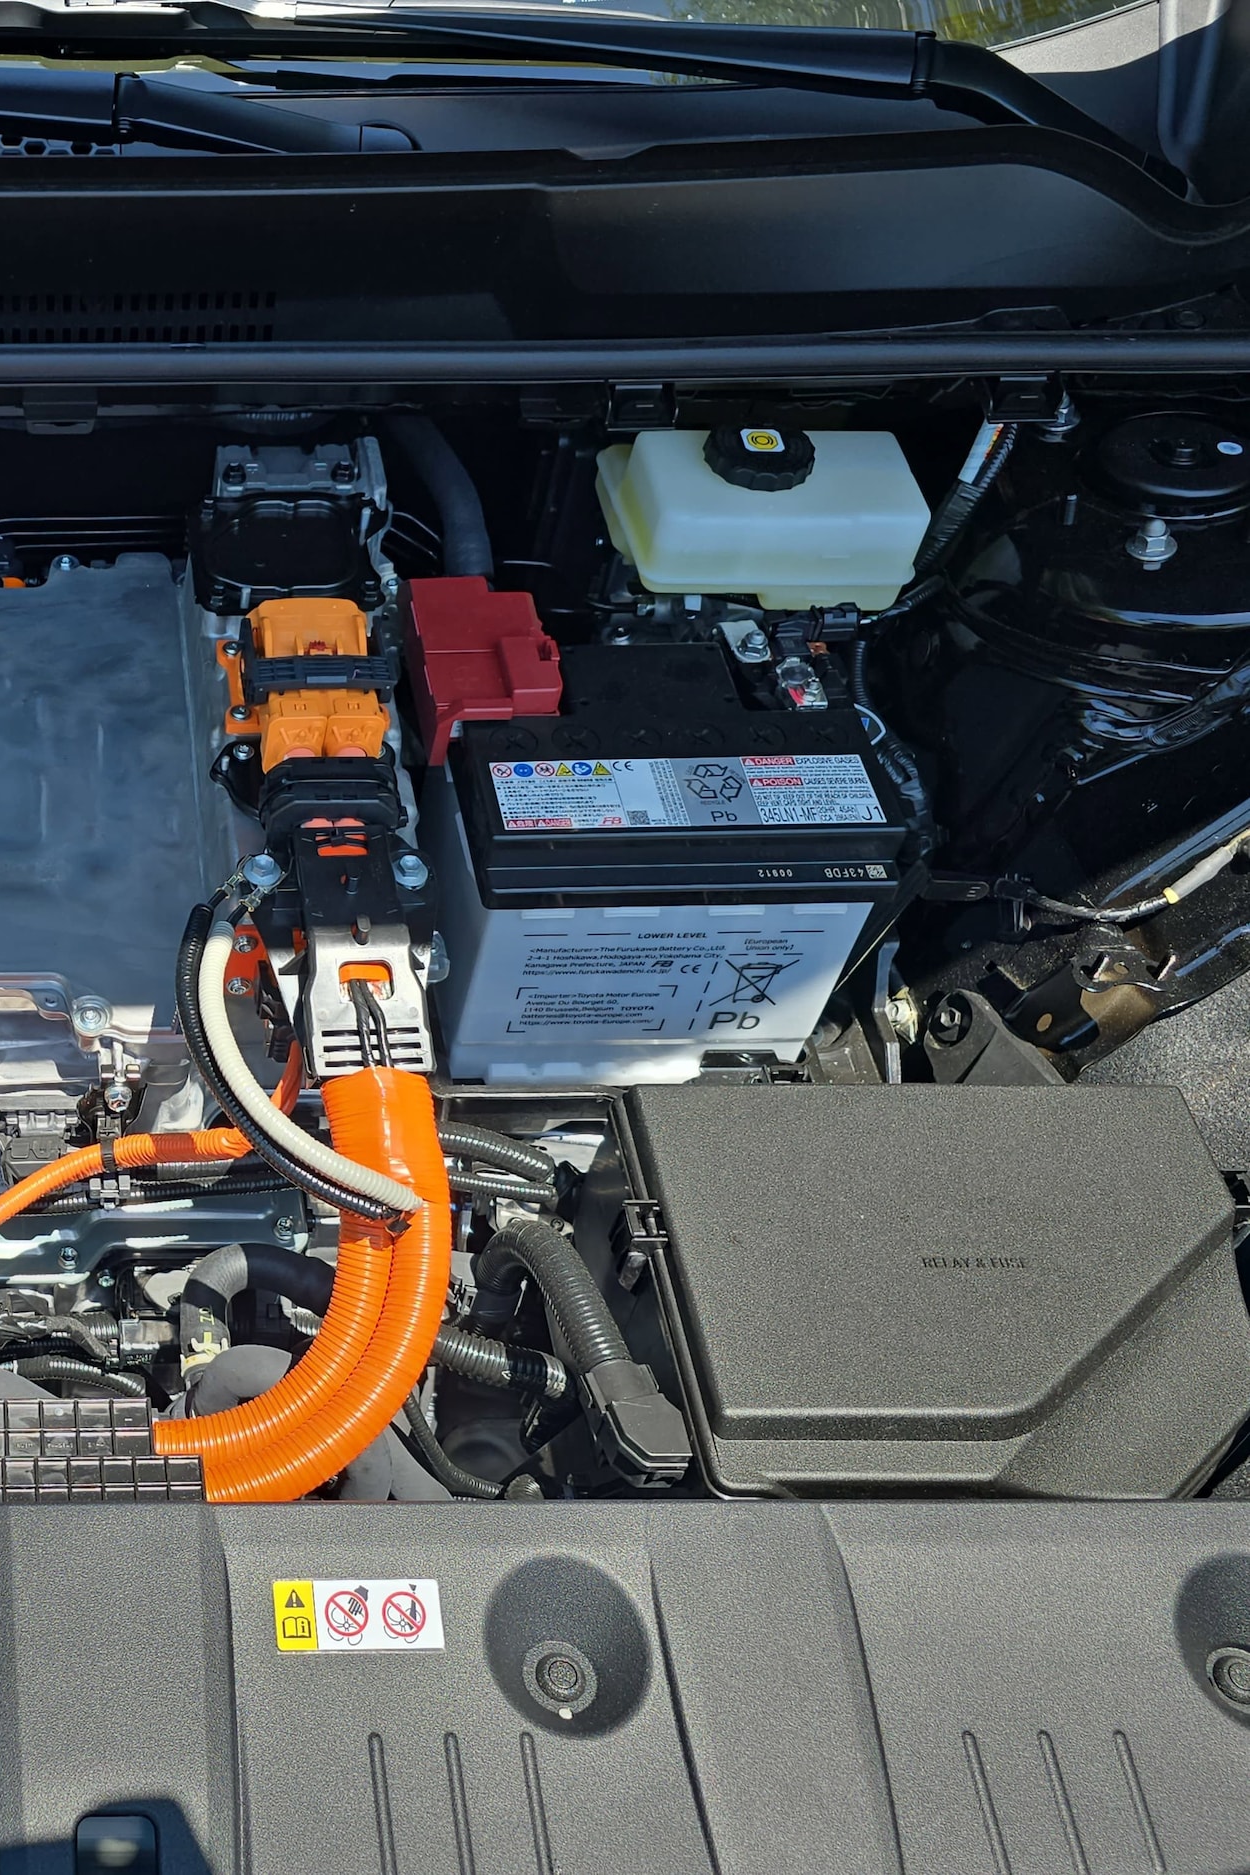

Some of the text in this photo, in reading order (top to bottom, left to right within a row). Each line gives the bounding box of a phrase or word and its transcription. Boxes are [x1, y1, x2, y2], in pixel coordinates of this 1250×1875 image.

[612, 760, 634, 772] CE
[754, 756, 860, 765] DANGER EXPLOSIVE GASES
[762, 777, 869, 786] POISON CAUSES SEVERE BURNS
[711, 810, 738, 822] Pb
[760, 807, 817, 823] 345LN1-MF
[680, 964, 701, 974] CE
[631, 991, 660, 999] Europe
[707, 1011, 760, 1030] Pb
[975, 1257, 987, 1268] &
